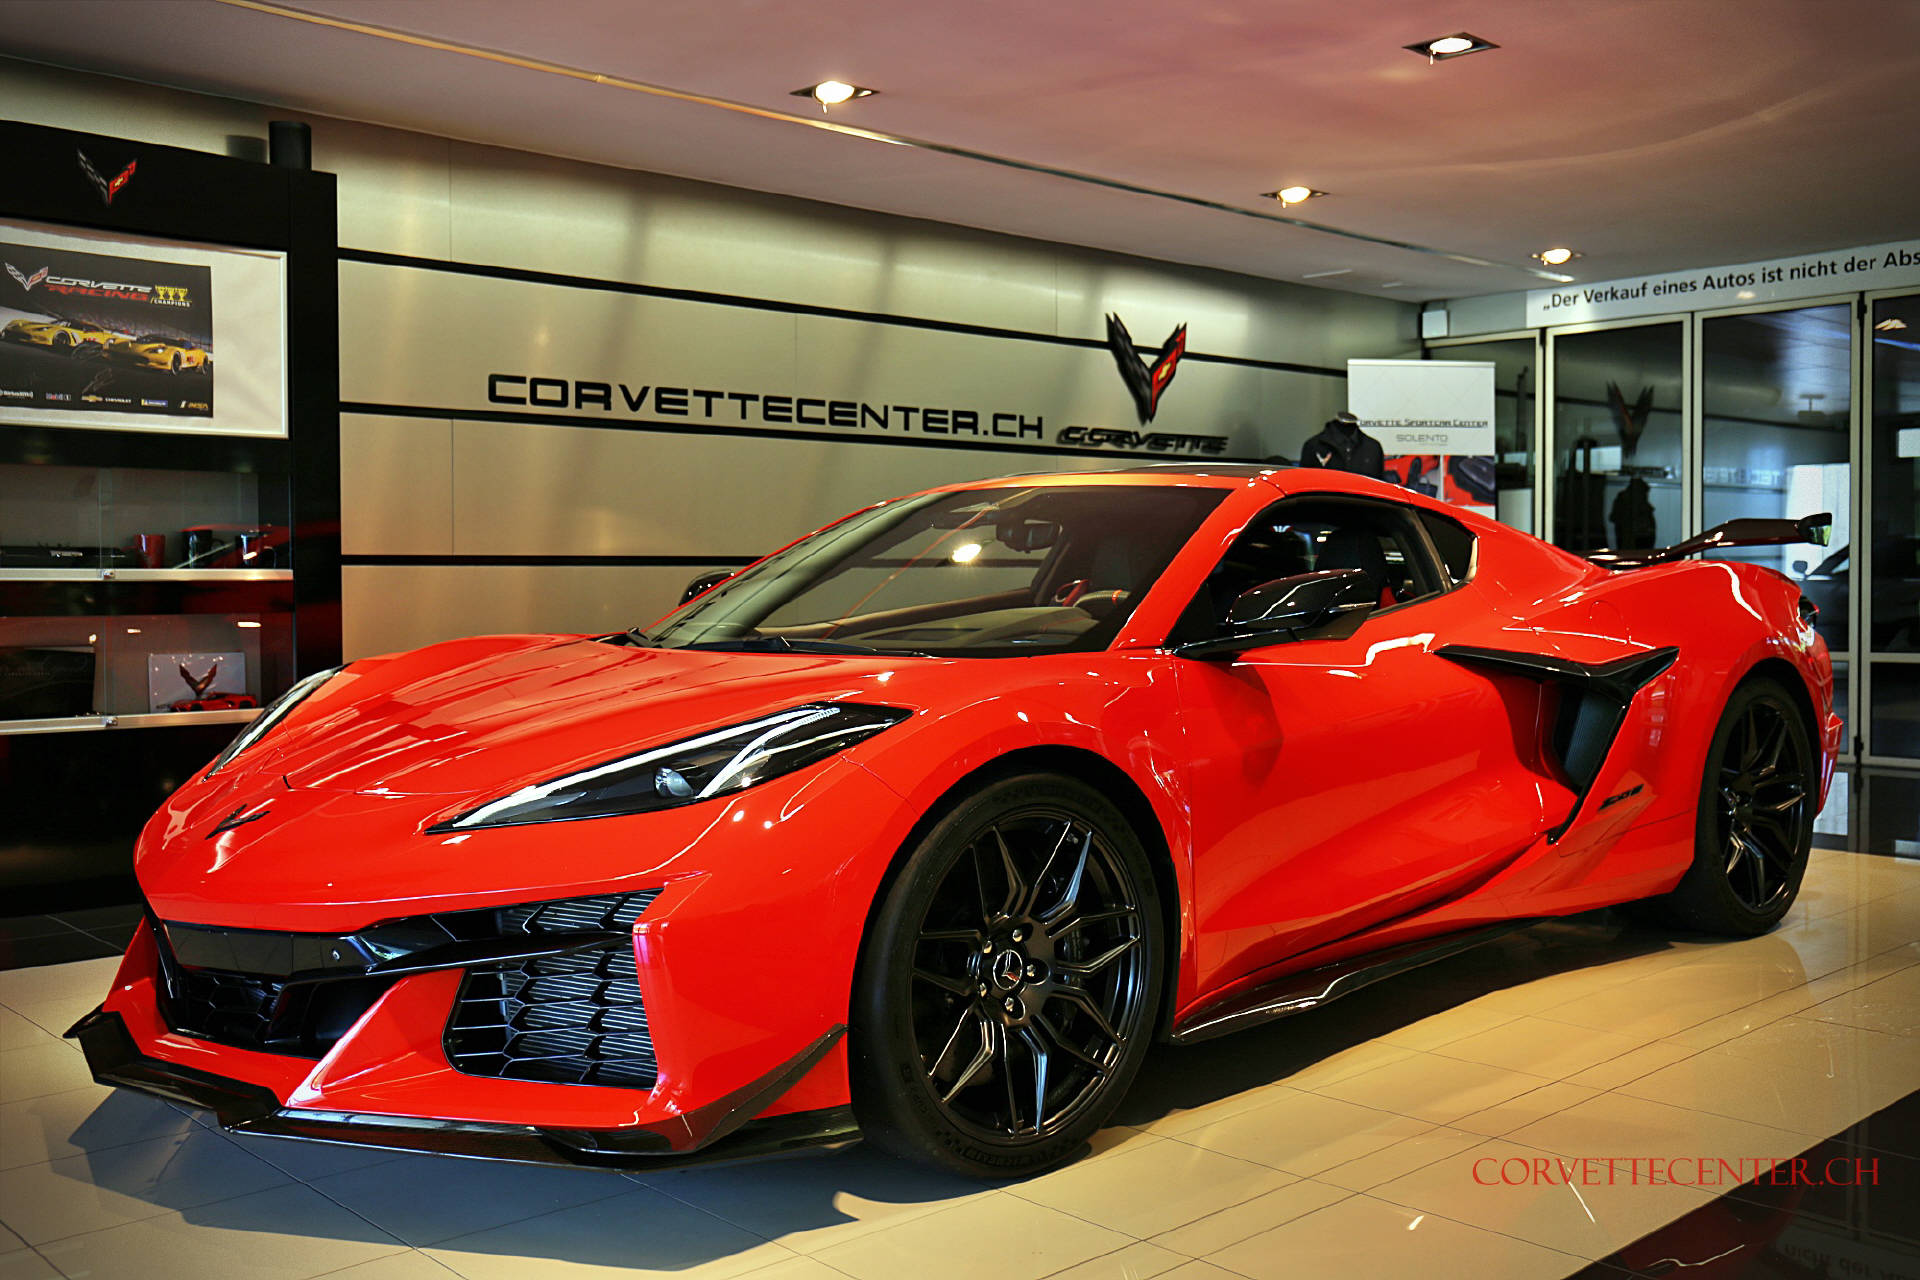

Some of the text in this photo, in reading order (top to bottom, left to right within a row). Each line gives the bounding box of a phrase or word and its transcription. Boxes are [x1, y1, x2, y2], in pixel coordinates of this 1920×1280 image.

[46, 275, 152, 293] CORVETTE
[1583, 281, 1648, 304] Verkauf
[1653, 279, 1698, 297] eines
[1702, 272, 1756, 291] Autos
[1761, 267, 1784, 284] ist
[1789, 260, 1838, 281] nicht
[1843, 256, 1877, 273] der
[45, 283, 149, 301] RACING
[489, 374, 1043, 439] CORVETTECENTER.CH
[1059, 426, 1229, 452] CORVETTE
[1396, 433, 1448, 443] SOLENTO
